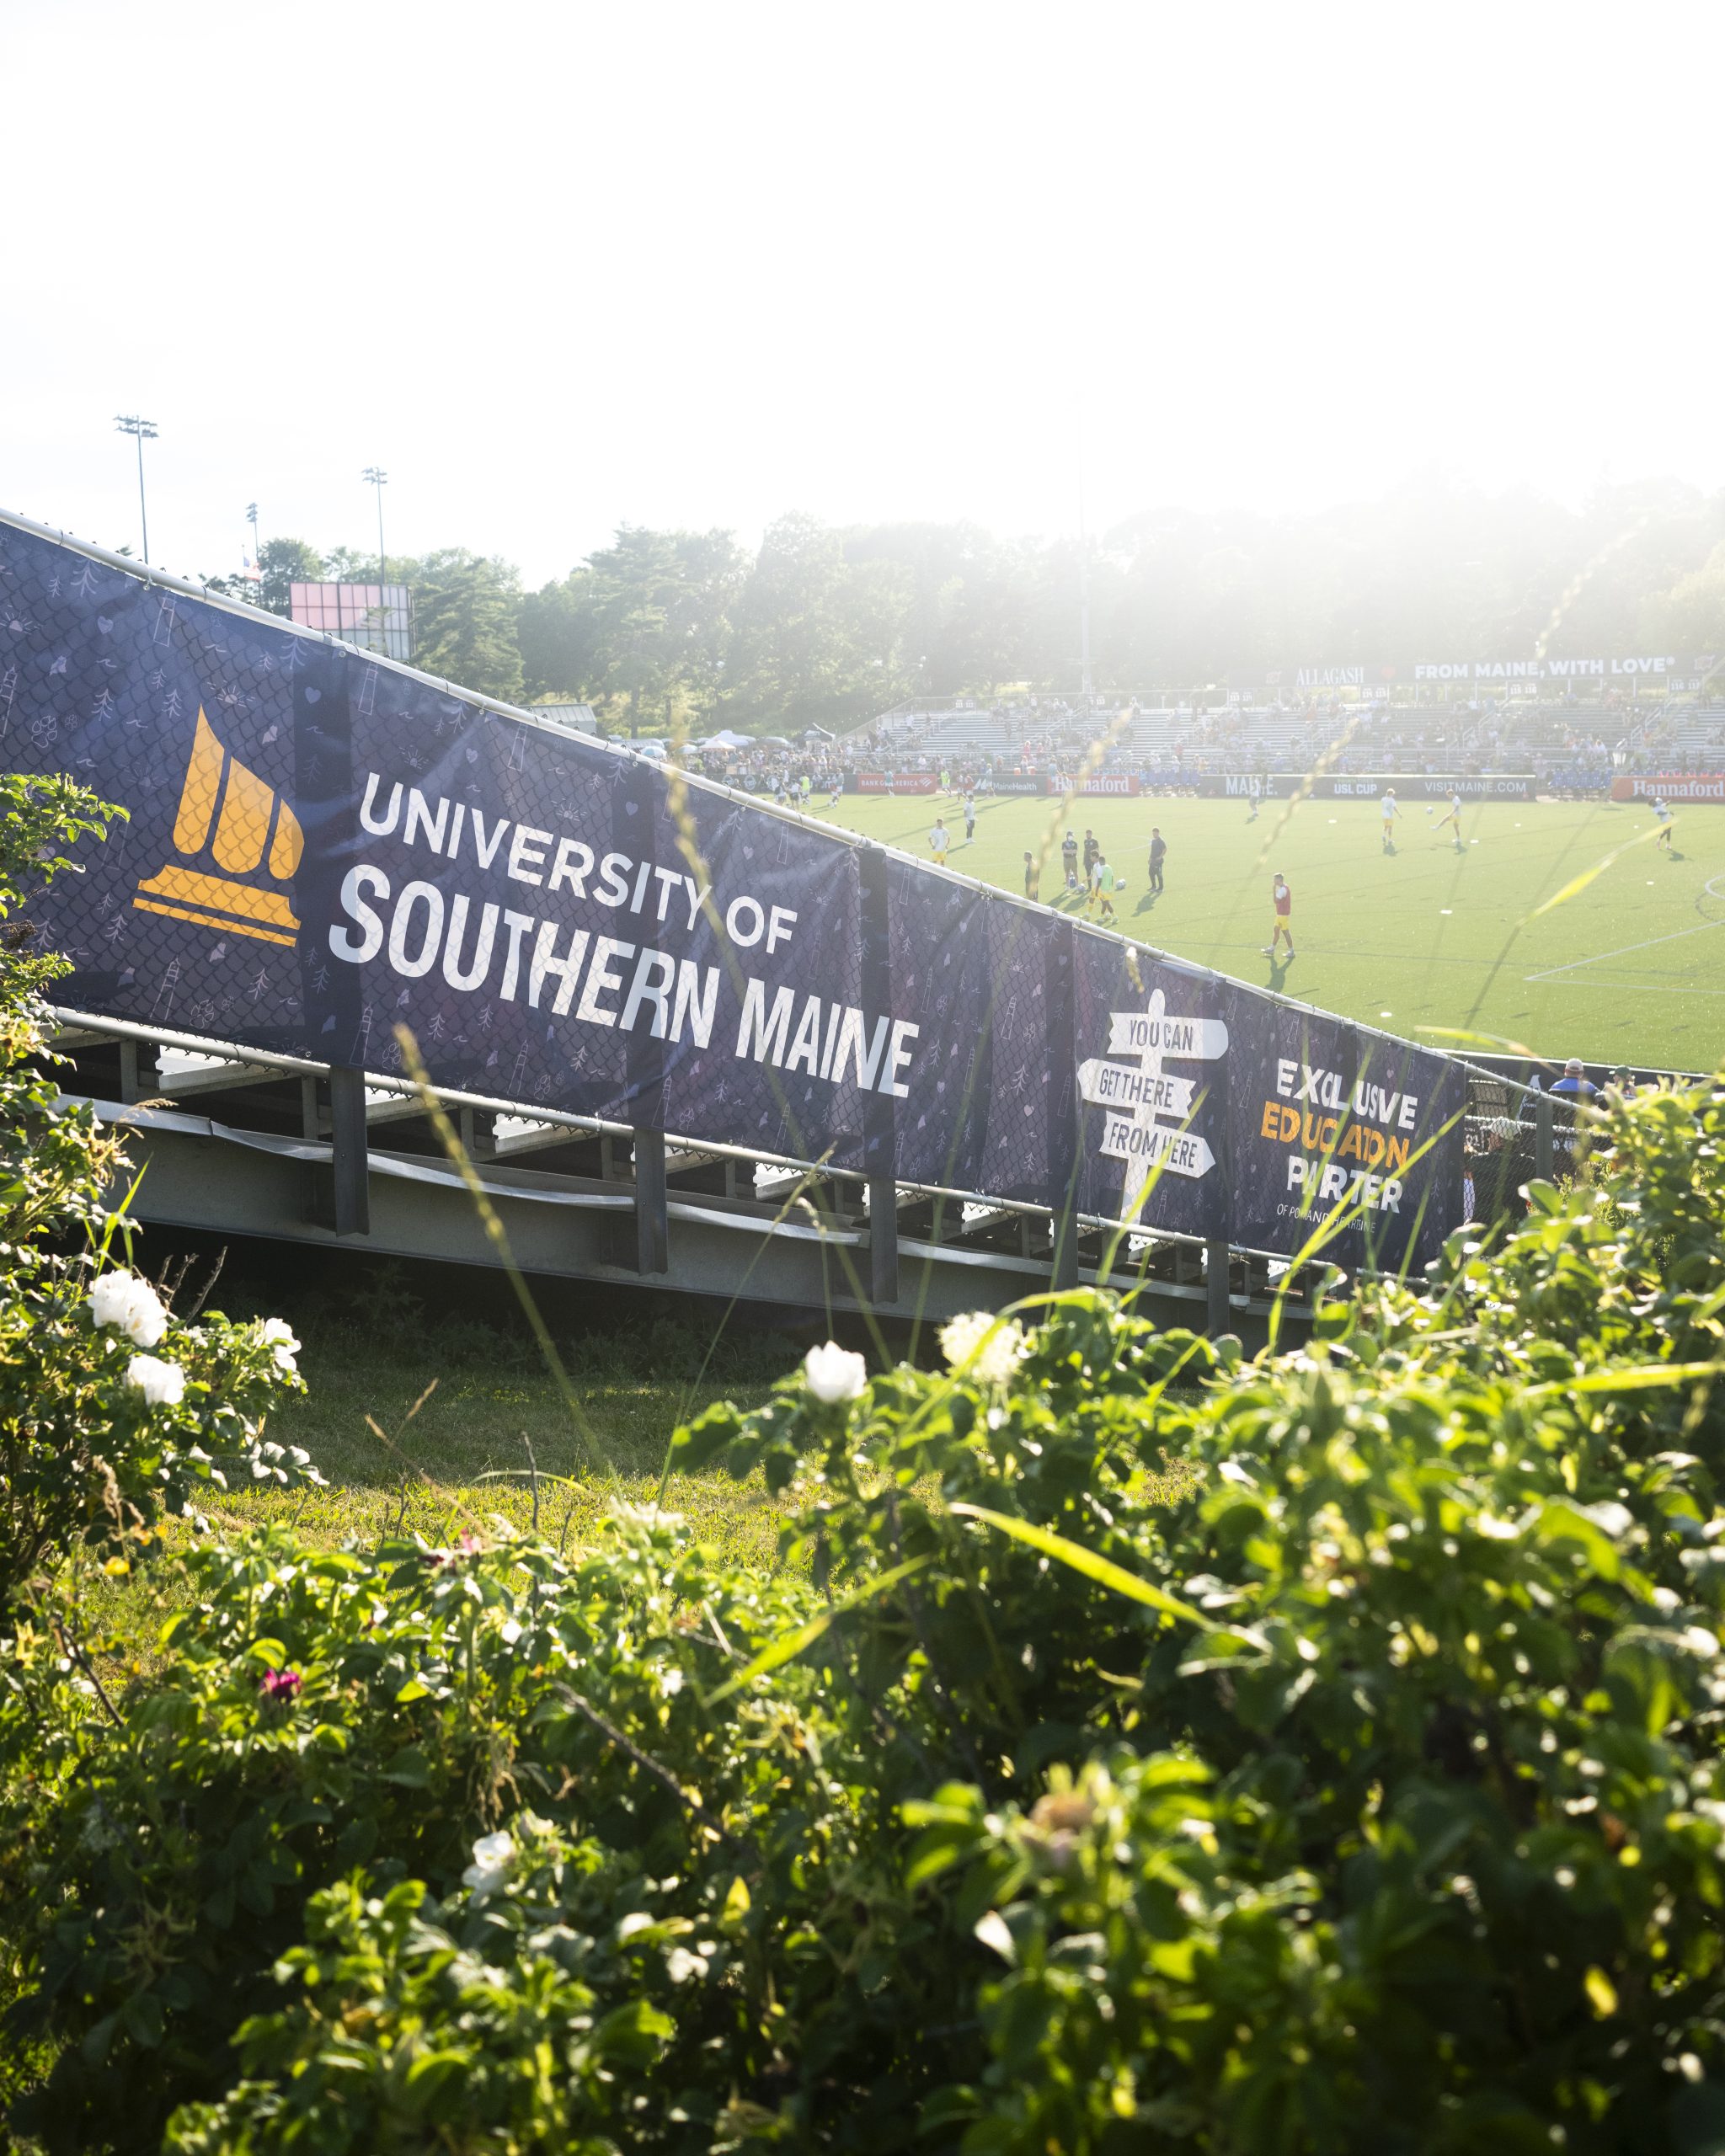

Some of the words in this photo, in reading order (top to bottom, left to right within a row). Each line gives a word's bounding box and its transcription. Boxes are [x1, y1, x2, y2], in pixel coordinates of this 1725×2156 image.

[1297, 666, 1365, 686] ALLAGASH
[1415, 662, 1469, 680] FROM
[1475, 659, 1545, 678] MAINE,
[1549, 659, 1604, 675] WITH
[1333, 783, 1354, 795] USL
[1356, 783, 1378, 795] CUP
[1424, 781, 1527, 793] VISITMAINE.COM
[1632, 780, 1725, 797] Hannaford
[360, 771, 712, 931] UNIVERSITY
[725, 894, 798, 954] OF
[328, 863, 721, 1050] SOUTHERN
[734, 977, 920, 1099] MAINE
[1130, 1020, 1160, 1047] YOU
[1163, 1022, 1193, 1051] CAN
[1099, 1068, 1120, 1097] GET
[1122, 1073, 1174, 1108] THERE
[1109, 1122, 1158, 1158] FROM
[1162, 1134, 1198, 1169] HERE
[1277, 1203, 1289, 1216] OF
